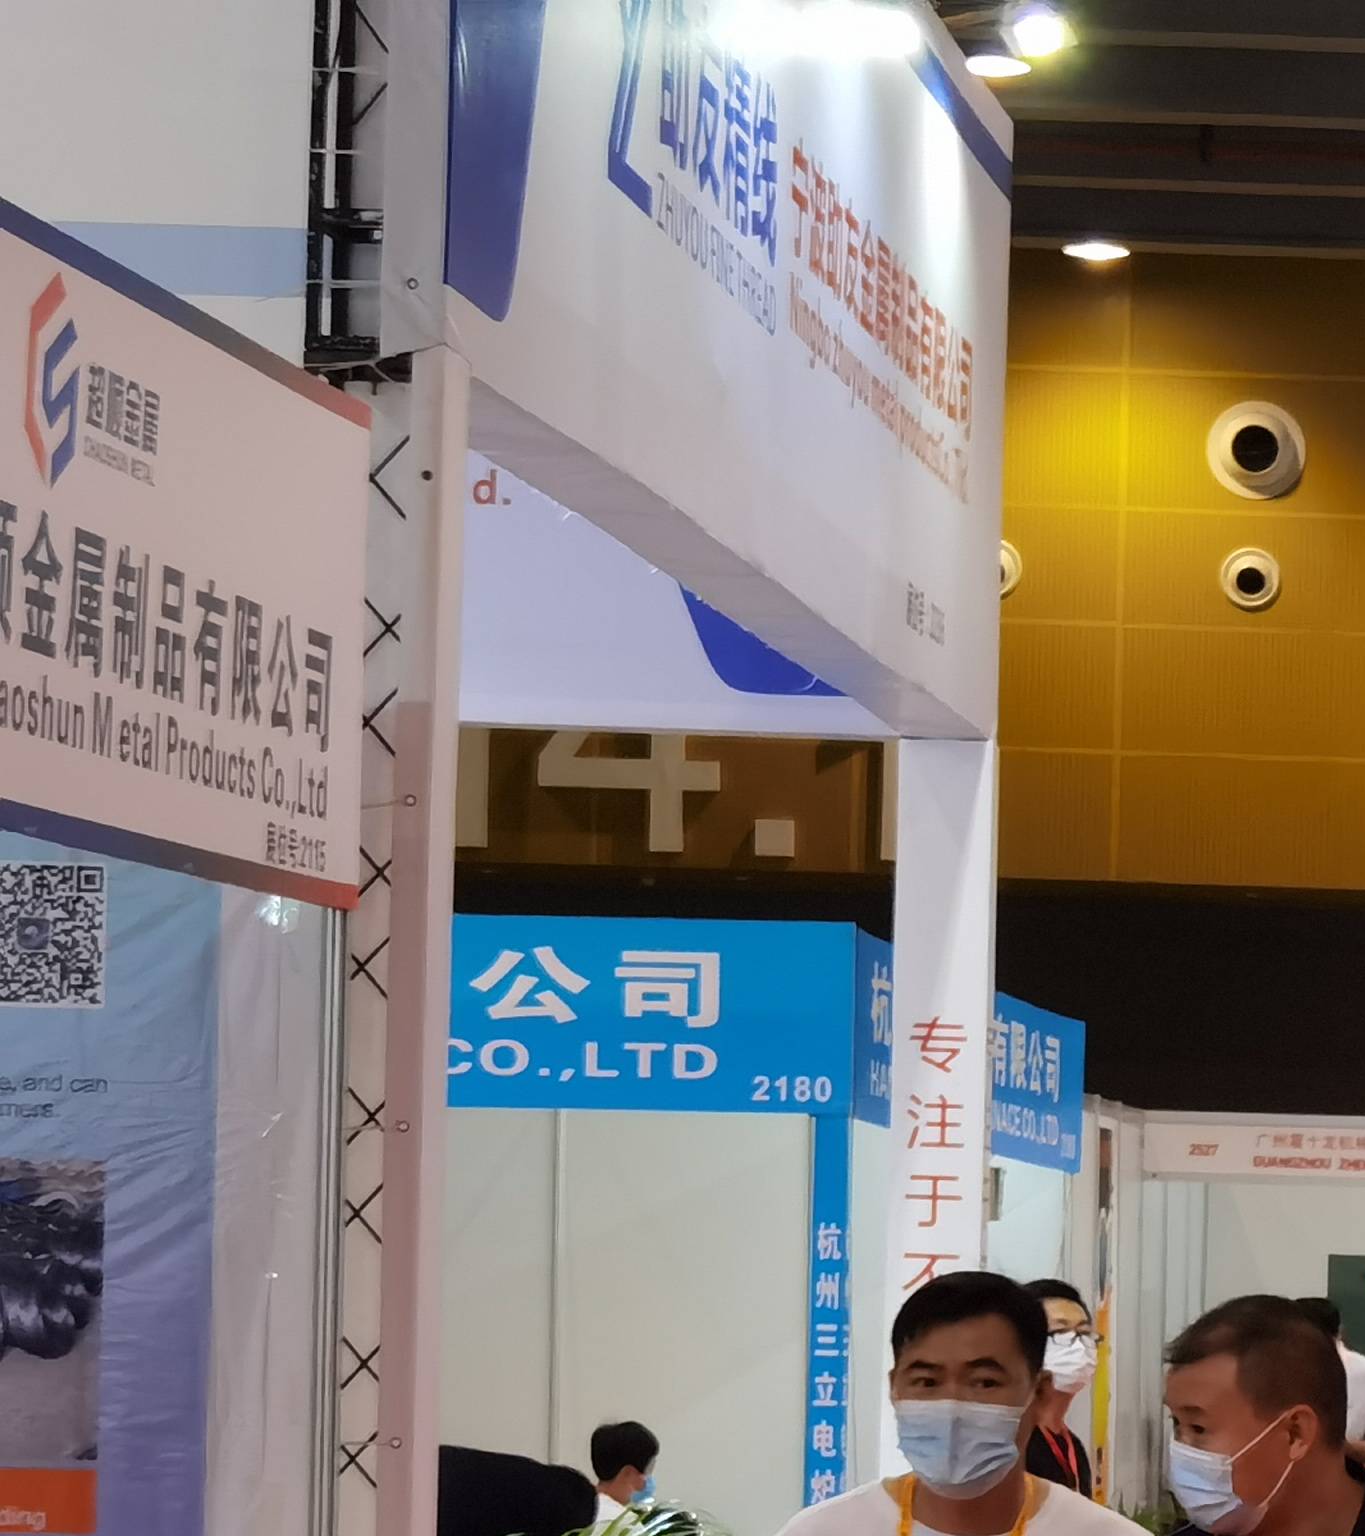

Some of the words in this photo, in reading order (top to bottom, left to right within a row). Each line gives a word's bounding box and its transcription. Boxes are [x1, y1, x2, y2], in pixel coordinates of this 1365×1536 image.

[165, 714, 256, 801] Products
[469, 945, 721, 1029] 公司
[751, 1074, 833, 1103] 2180
